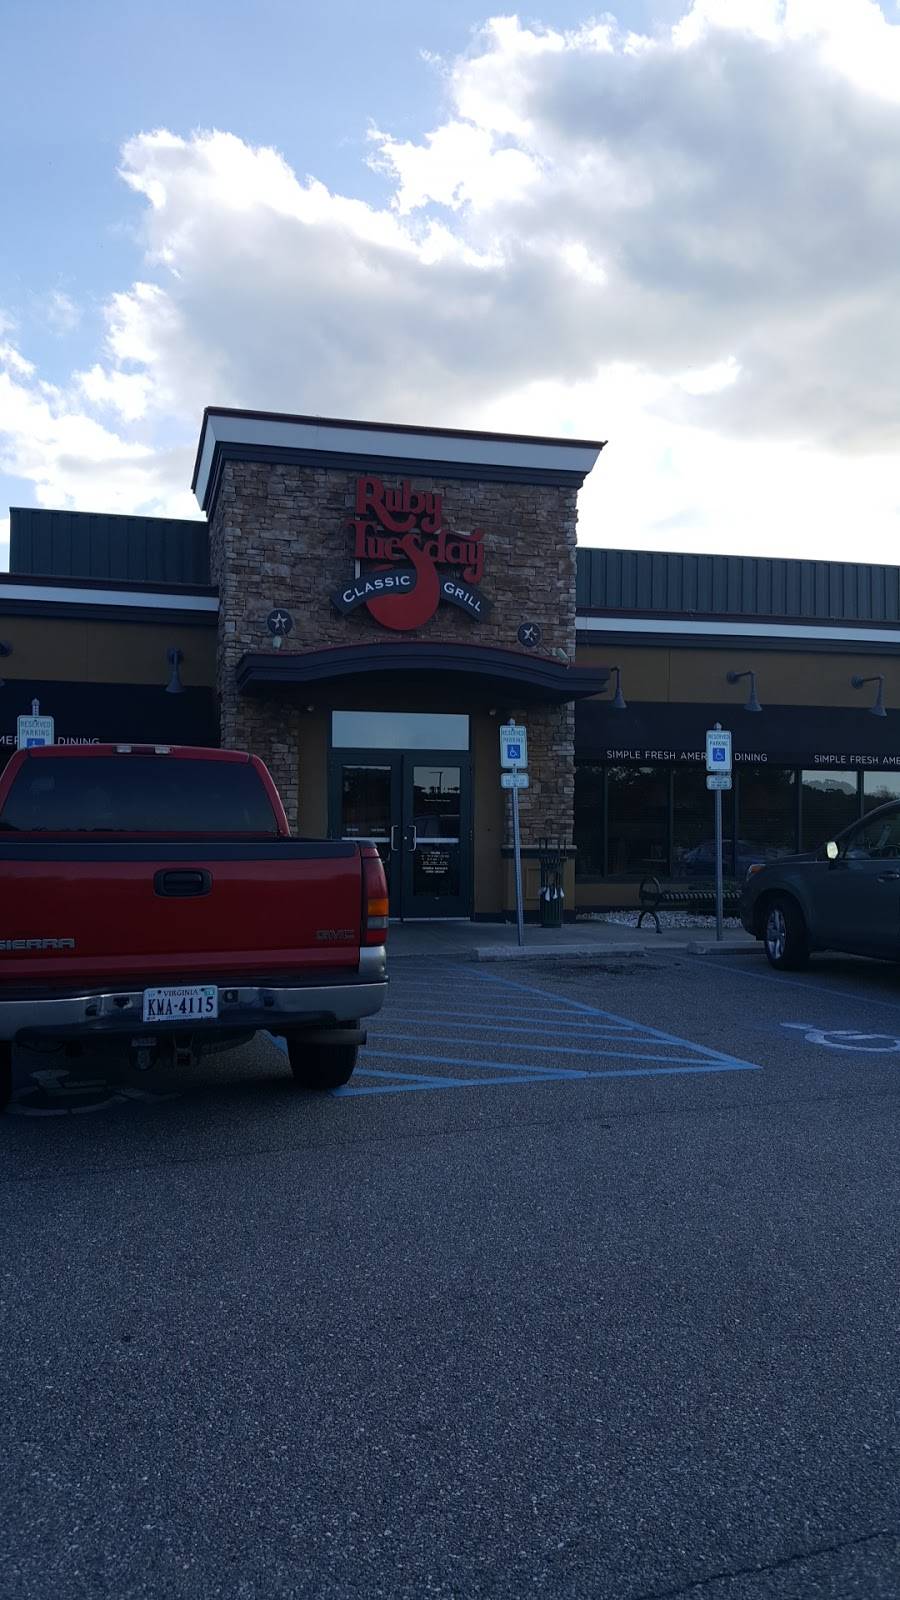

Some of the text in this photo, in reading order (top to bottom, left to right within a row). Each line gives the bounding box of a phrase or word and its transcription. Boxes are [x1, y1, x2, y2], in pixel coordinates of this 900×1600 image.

[355, 475, 442, 534] Ruby
[345, 518, 485, 630] Tuesday
[342, 575, 481, 612] CLASSIC GRILL
[20, 720, 51, 728] RESERVED
[0, 736, 18, 745] MER
[606, 750, 768, 762] SIMPLE FRESH AMER DINING
[814, 754, 900, 765] SIMPLE FRESH AME
[163, 987, 200, 997] VIRGINIA
[147, 995, 214, 1016] KMA-4115
